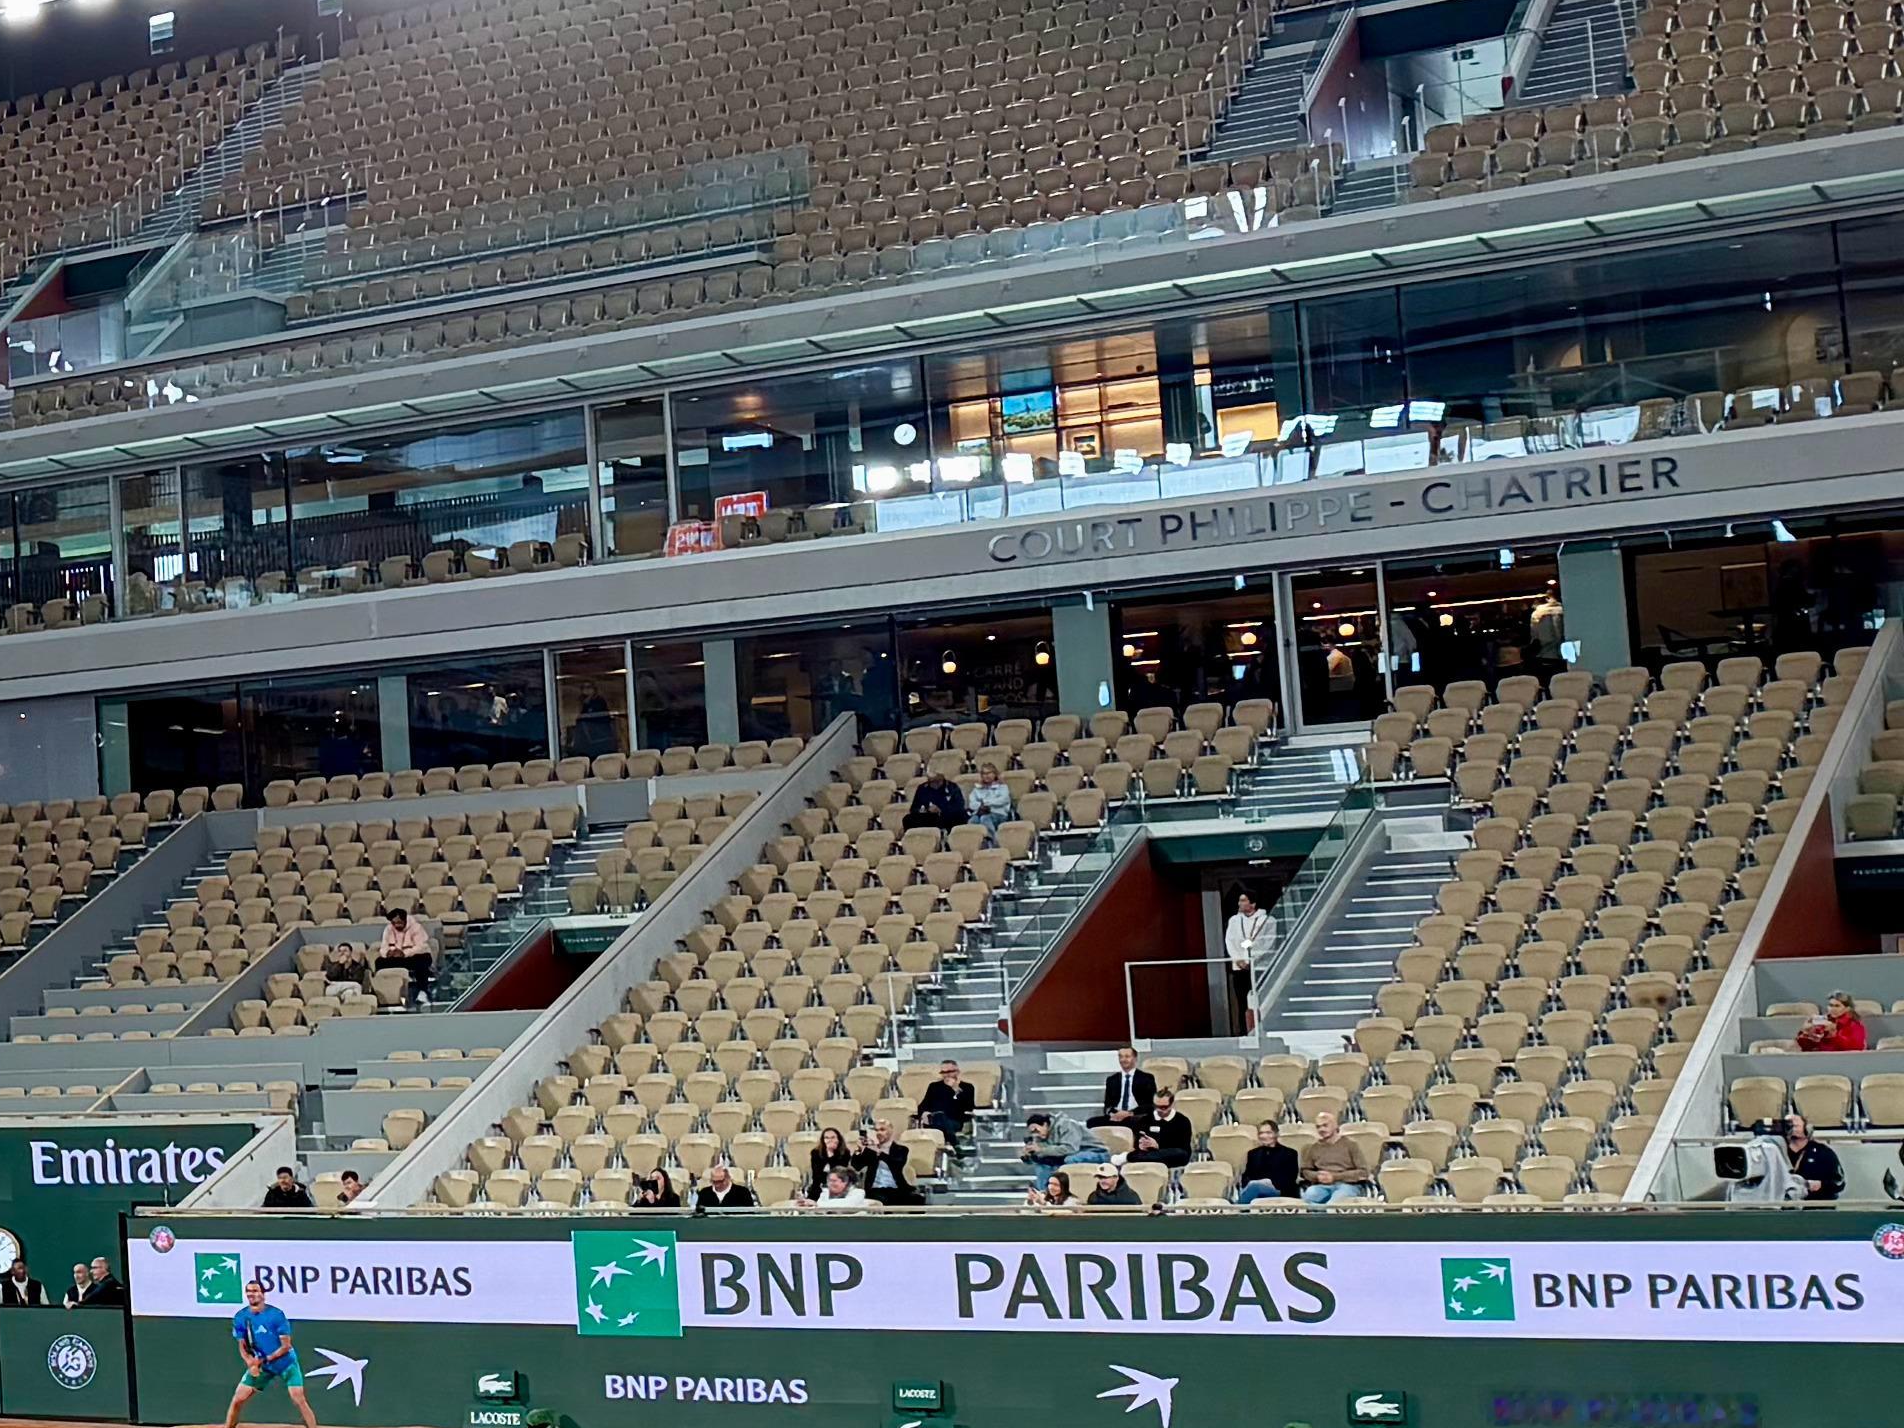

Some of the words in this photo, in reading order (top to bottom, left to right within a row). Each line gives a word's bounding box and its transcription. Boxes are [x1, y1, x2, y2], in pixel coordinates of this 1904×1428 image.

[988, 517, 1142, 563] COURT
[1159, 491, 1373, 546] PHILIPPE
[1422, 456, 1680, 514] CHATRIER
[29, 1138, 225, 1185] Emirates
[254, 1265, 320, 1294] BNP
[330, 1266, 473, 1297] PARIBAS
[699, 1252, 864, 1317] BNP
[953, 1251, 1338, 1324] PARIBAS
[1533, 1273, 1632, 1309] BNP
[1647, 1273, 1865, 1312] PARIBAS
[604, 1375, 667, 1400] BNP
[676, 1377, 809, 1404] PARIBAS
[470, 1411, 521, 1427] LACOSTE
